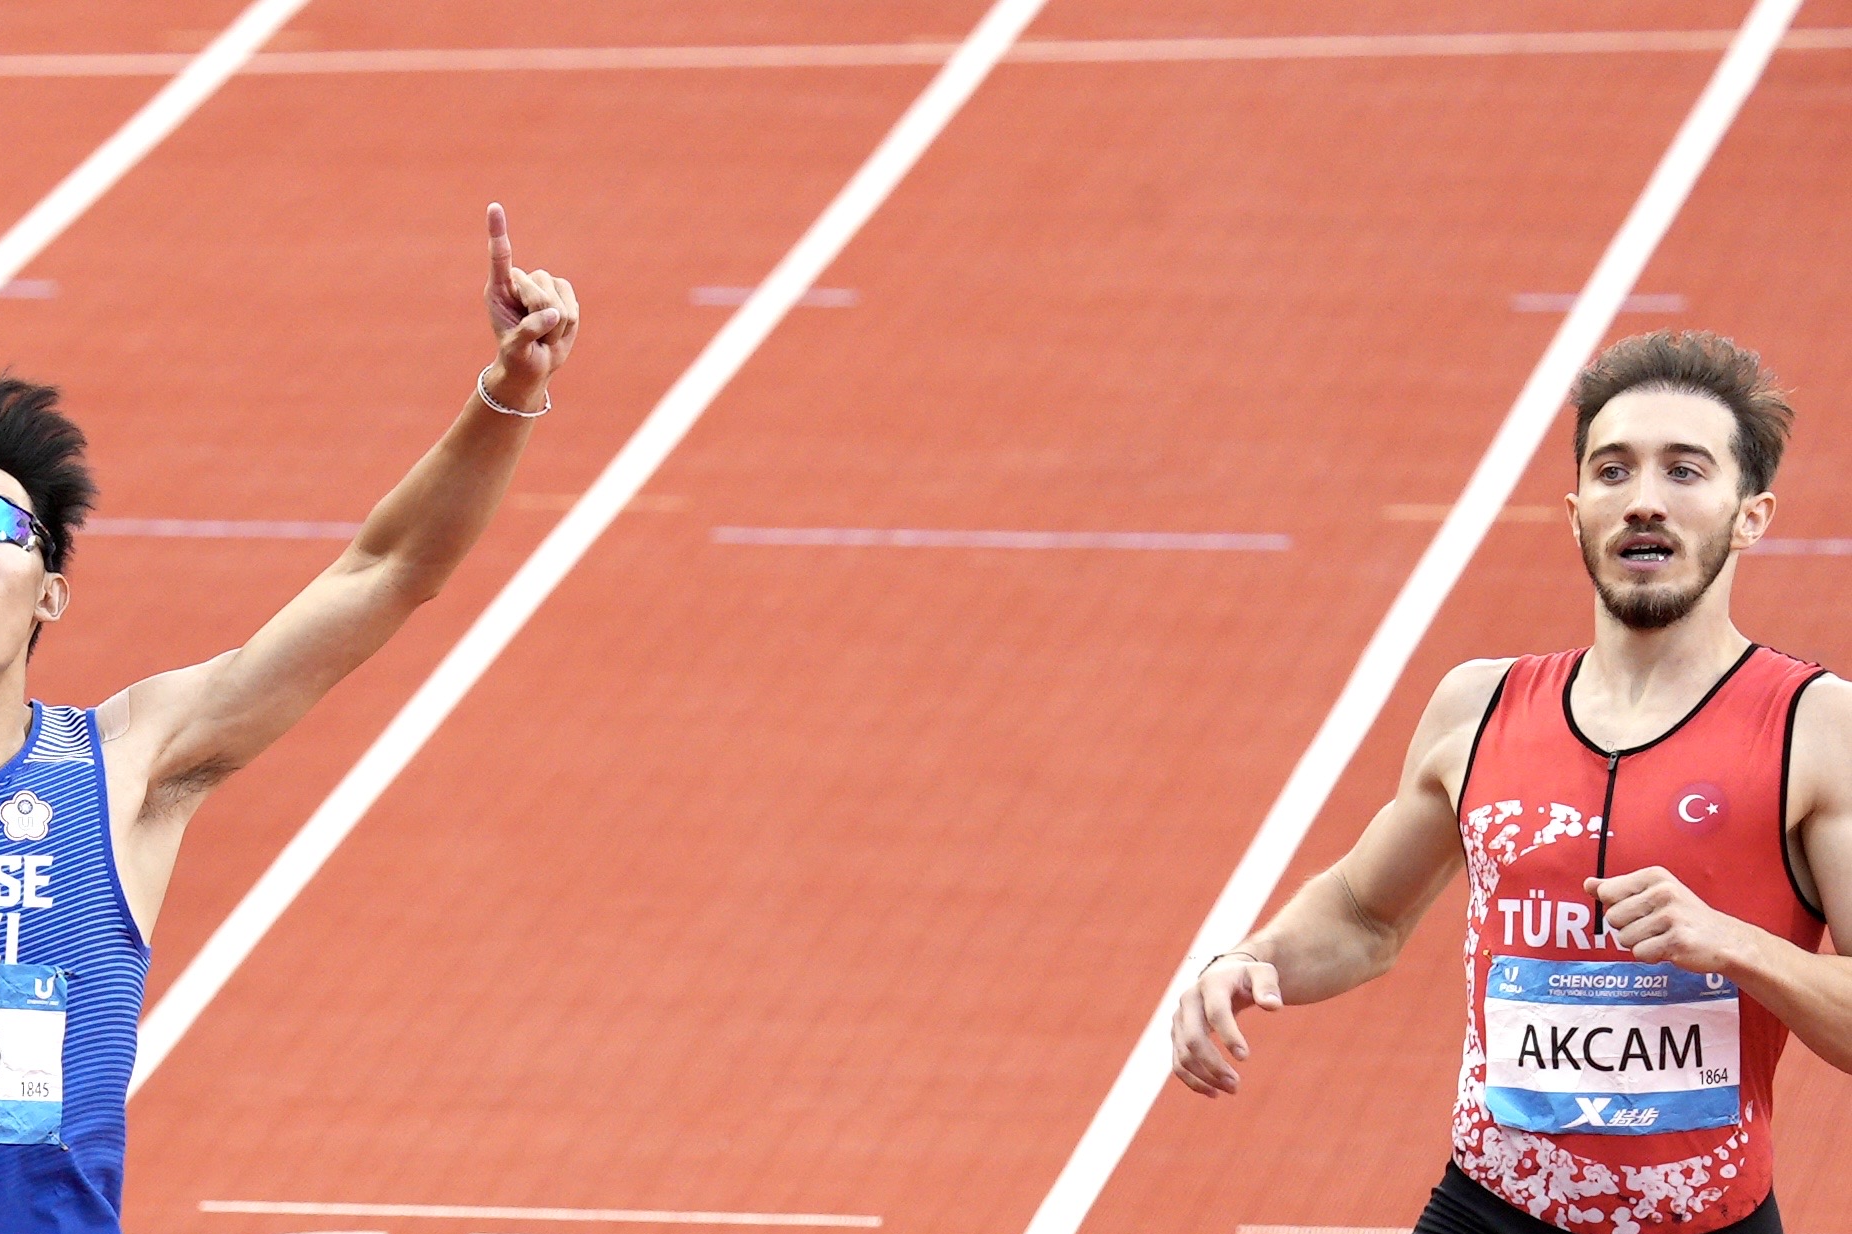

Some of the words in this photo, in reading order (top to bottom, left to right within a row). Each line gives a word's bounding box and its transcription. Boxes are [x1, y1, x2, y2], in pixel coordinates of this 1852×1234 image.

[1498, 889, 1631, 952] TÜRK
[1548, 974, 1628, 989] CHENGDU
[1633, 975, 1668, 989] 2021
[1518, 1023, 1703, 1072] AKCAM
[1699, 1067, 1729, 1085] 1864
[21, 1081, 50, 1098] 1845
[1607, 1107, 1660, 1127] 特步
